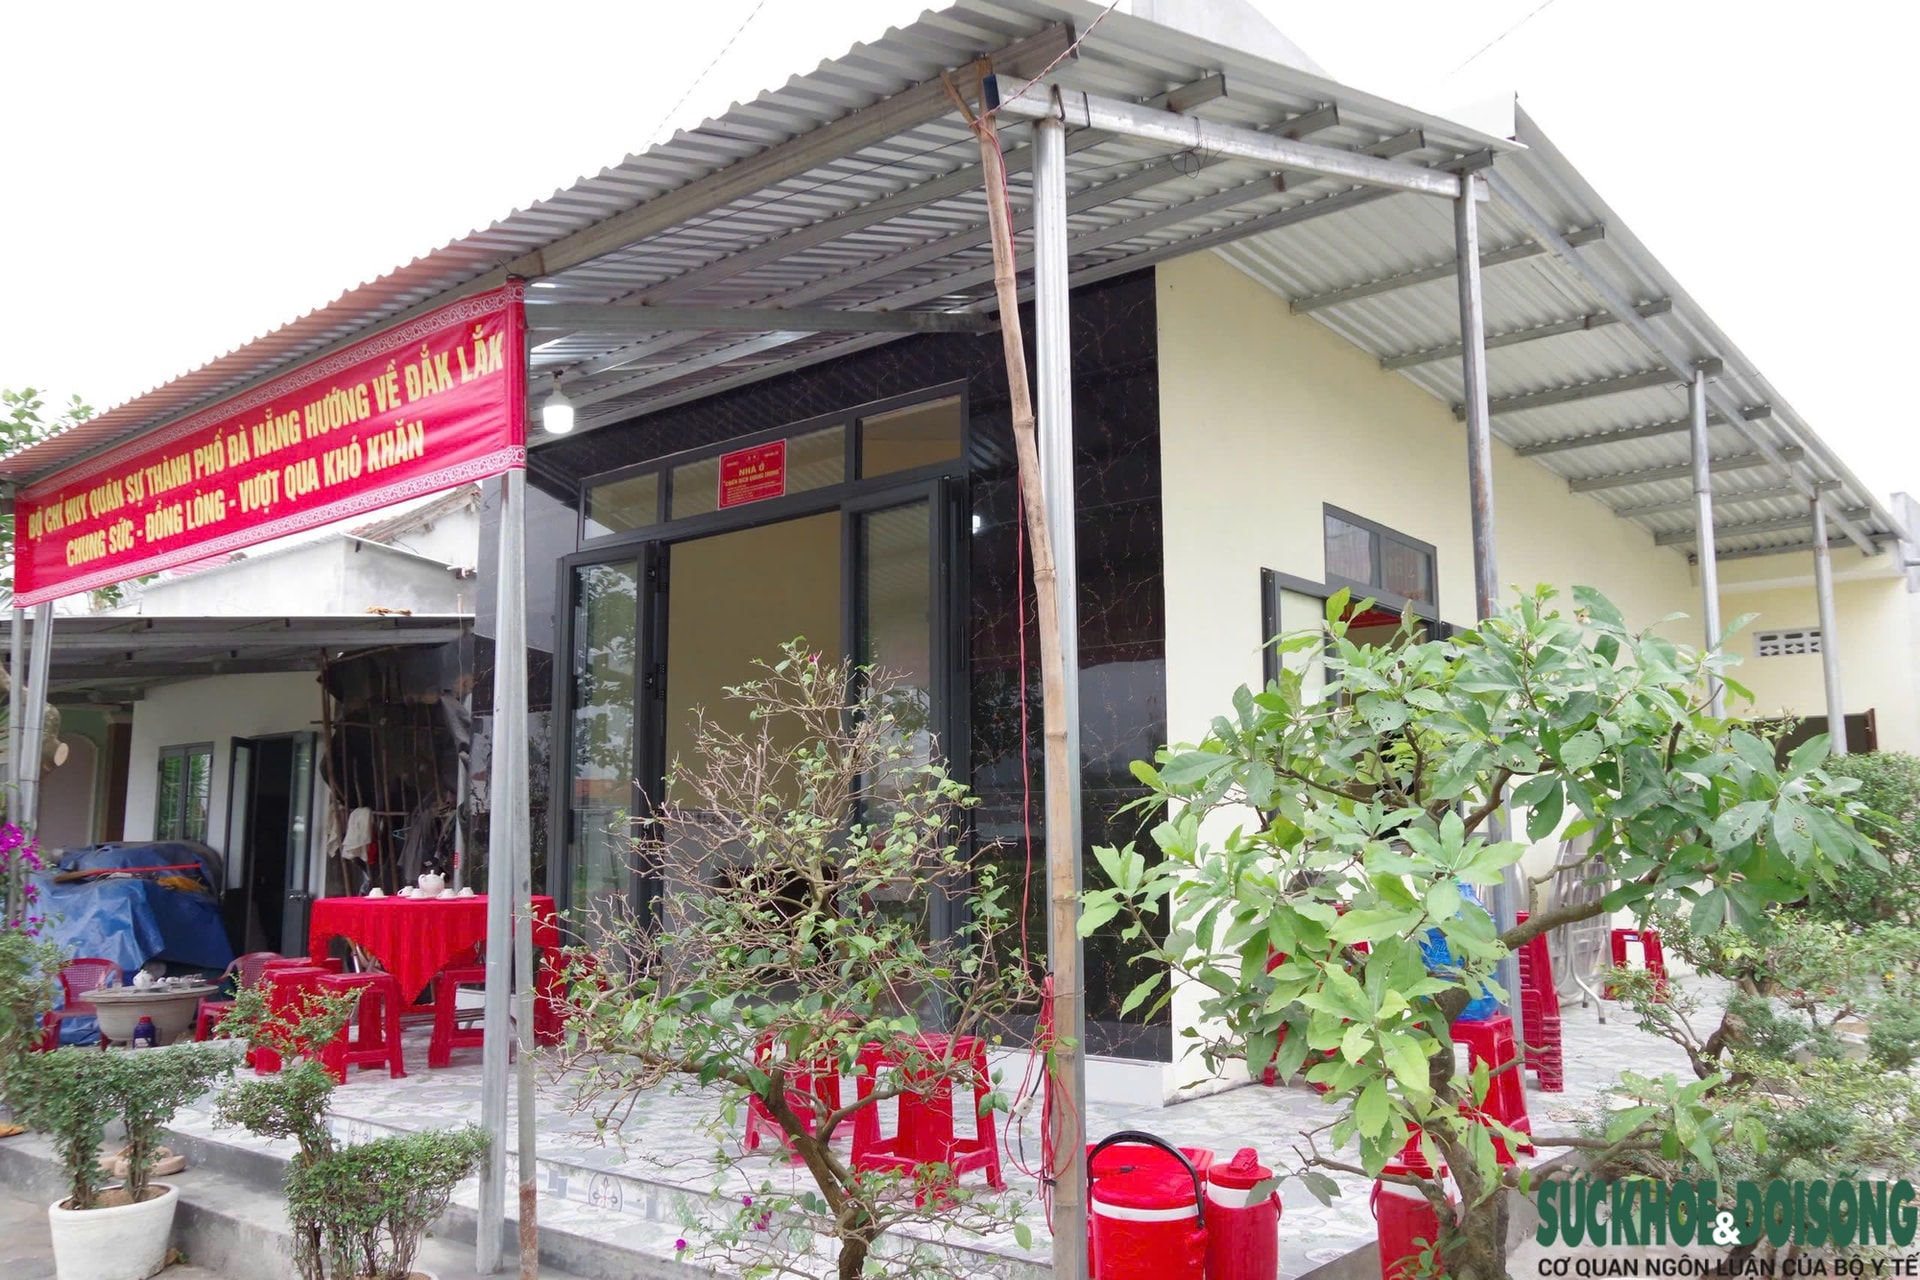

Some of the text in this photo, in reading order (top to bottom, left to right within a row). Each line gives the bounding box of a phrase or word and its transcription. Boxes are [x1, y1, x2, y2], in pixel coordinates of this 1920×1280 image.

[28, 506, 43, 542] BỘ
[64, 493, 87, 529] HUY
[89, 478, 125, 519] QUÂN
[125, 468, 145, 507] SỰ
[146, 453, 191, 496] THÀNH
[194, 429, 224, 479] PHỐ
[227, 425, 250, 467] ĐÀ
[252, 408, 301, 458] NẴNG
[304, 386, 370, 439] HƯỚNG
[372, 359, 401, 413] VỀ
[404, 343, 454, 403] ĐẮK
[457, 324, 504, 384] LẮK
[66, 529, 107, 567] CHUNG
[108, 517, 135, 554] SỨC
[145, 499, 184, 543] ĐỒNG
[187, 489, 226, 530] LÒNG
[239, 470, 280, 513] VƯỢT
[284, 458, 320, 501] QUA
[323, 435, 361, 487] KHÓ
[366, 419, 424, 473] KHĂN
